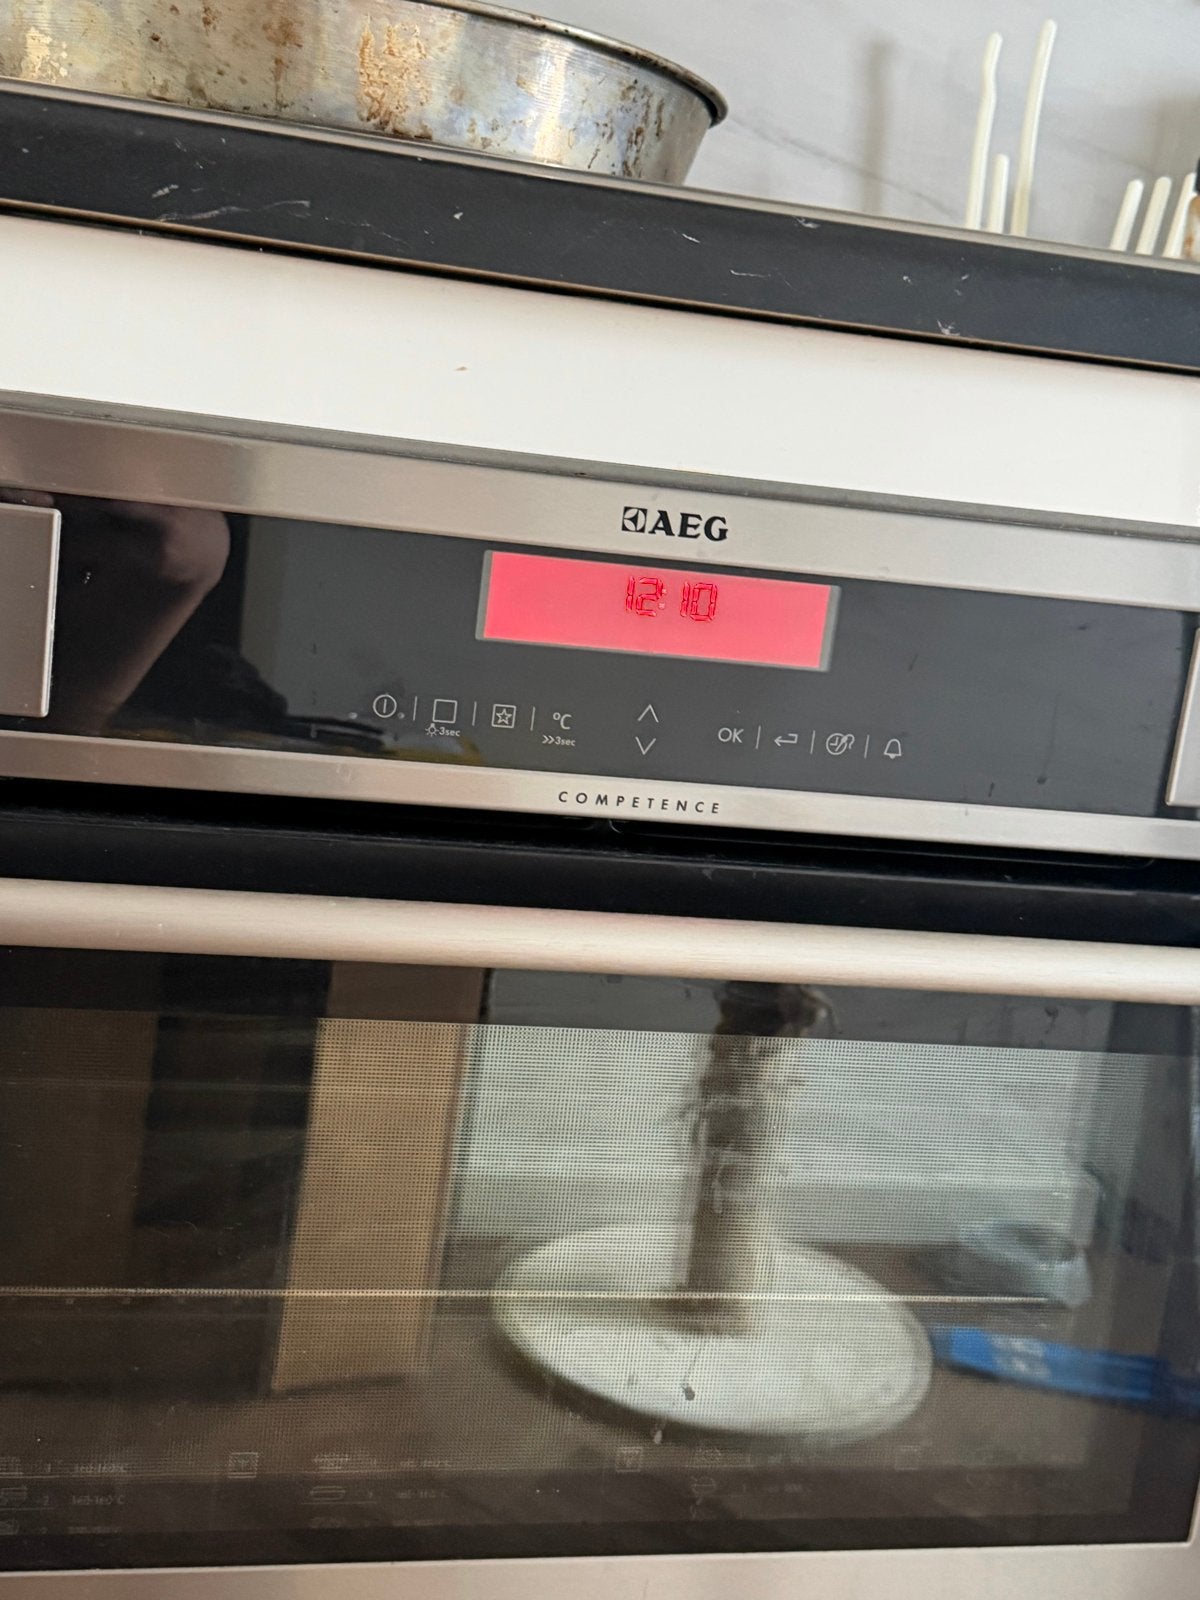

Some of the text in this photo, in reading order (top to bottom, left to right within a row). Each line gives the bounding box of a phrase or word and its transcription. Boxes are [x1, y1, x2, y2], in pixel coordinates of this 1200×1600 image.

[648, 509, 729, 542] AEG
[626, 575, 718, 622] 12:10
[439, 727, 461, 737] 3sec
[718, 727, 745, 744] OK
[558, 791, 720, 814] COMPETENCE
